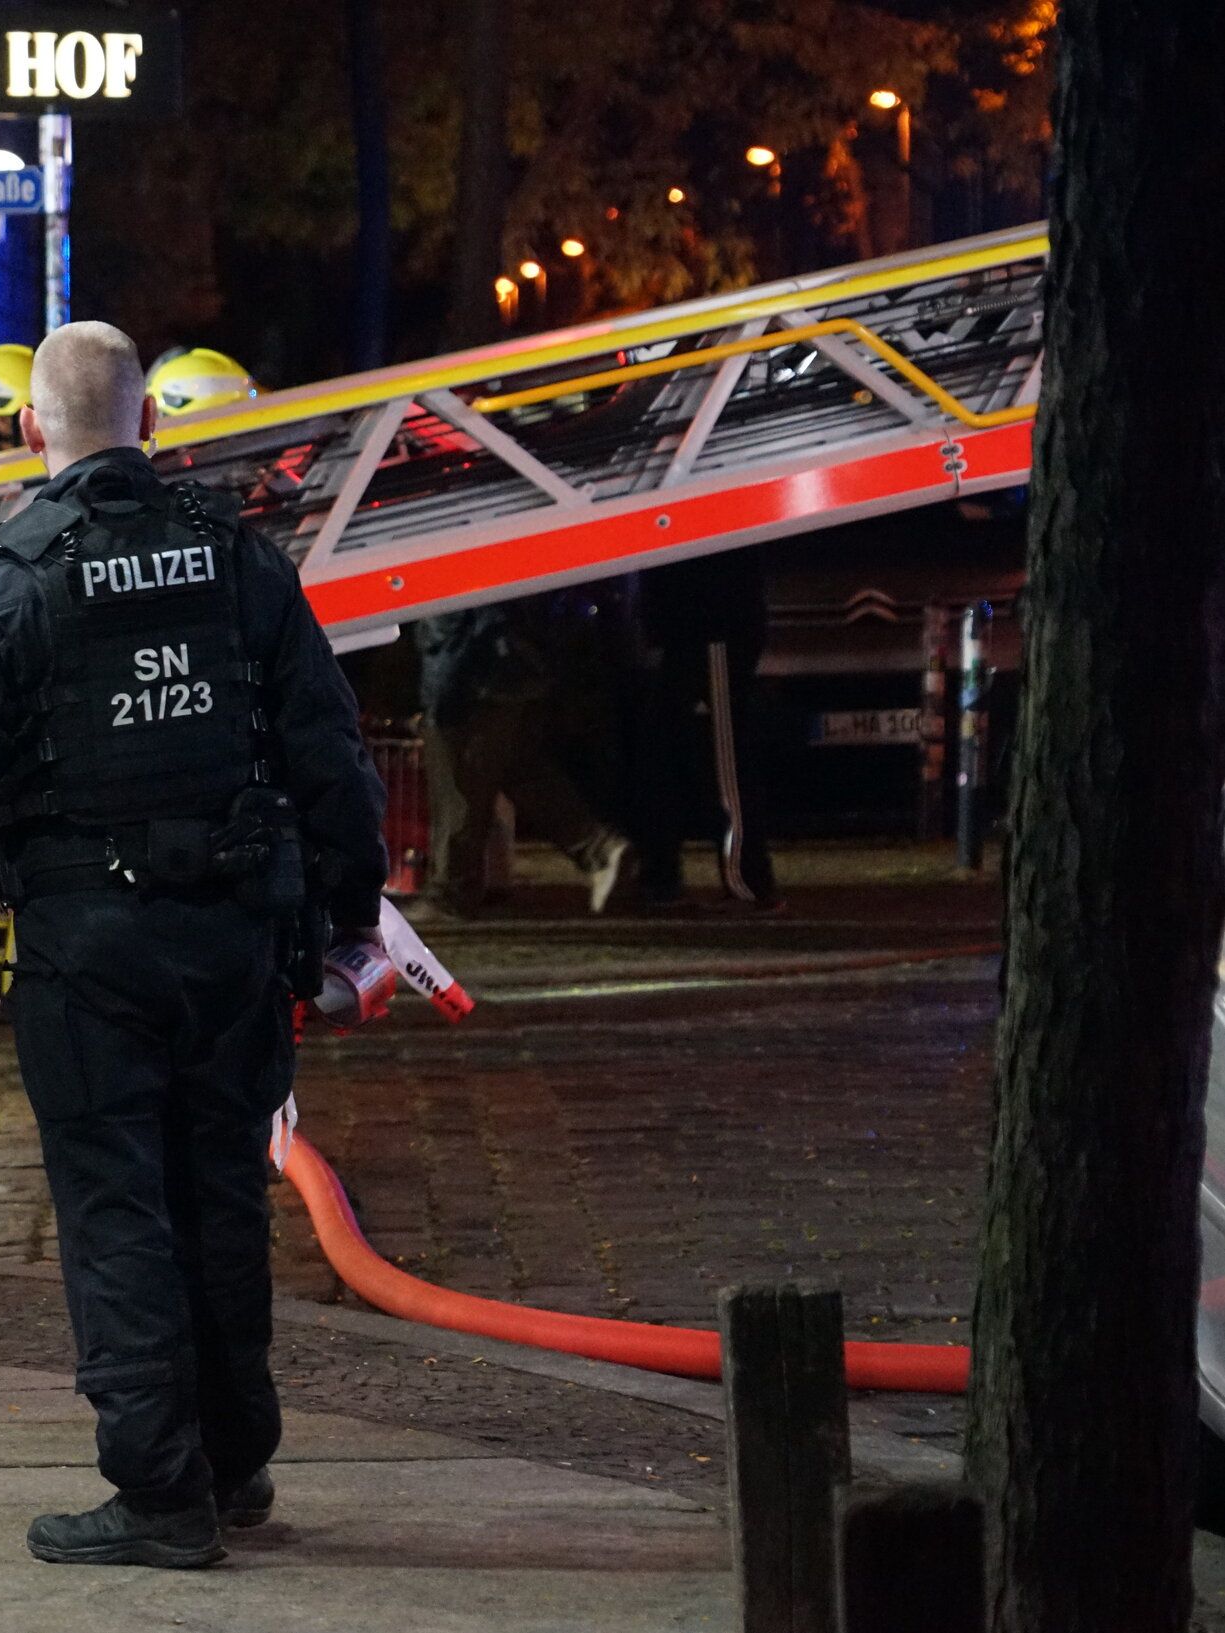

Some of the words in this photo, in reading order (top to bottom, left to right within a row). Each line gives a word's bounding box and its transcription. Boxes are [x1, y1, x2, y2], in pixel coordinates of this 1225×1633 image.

[6, 30, 144, 99] HOF
[82, 546, 216, 597] POLIZEI
[134, 643, 190, 681] SN
[111, 681, 213, 727] 21/23
